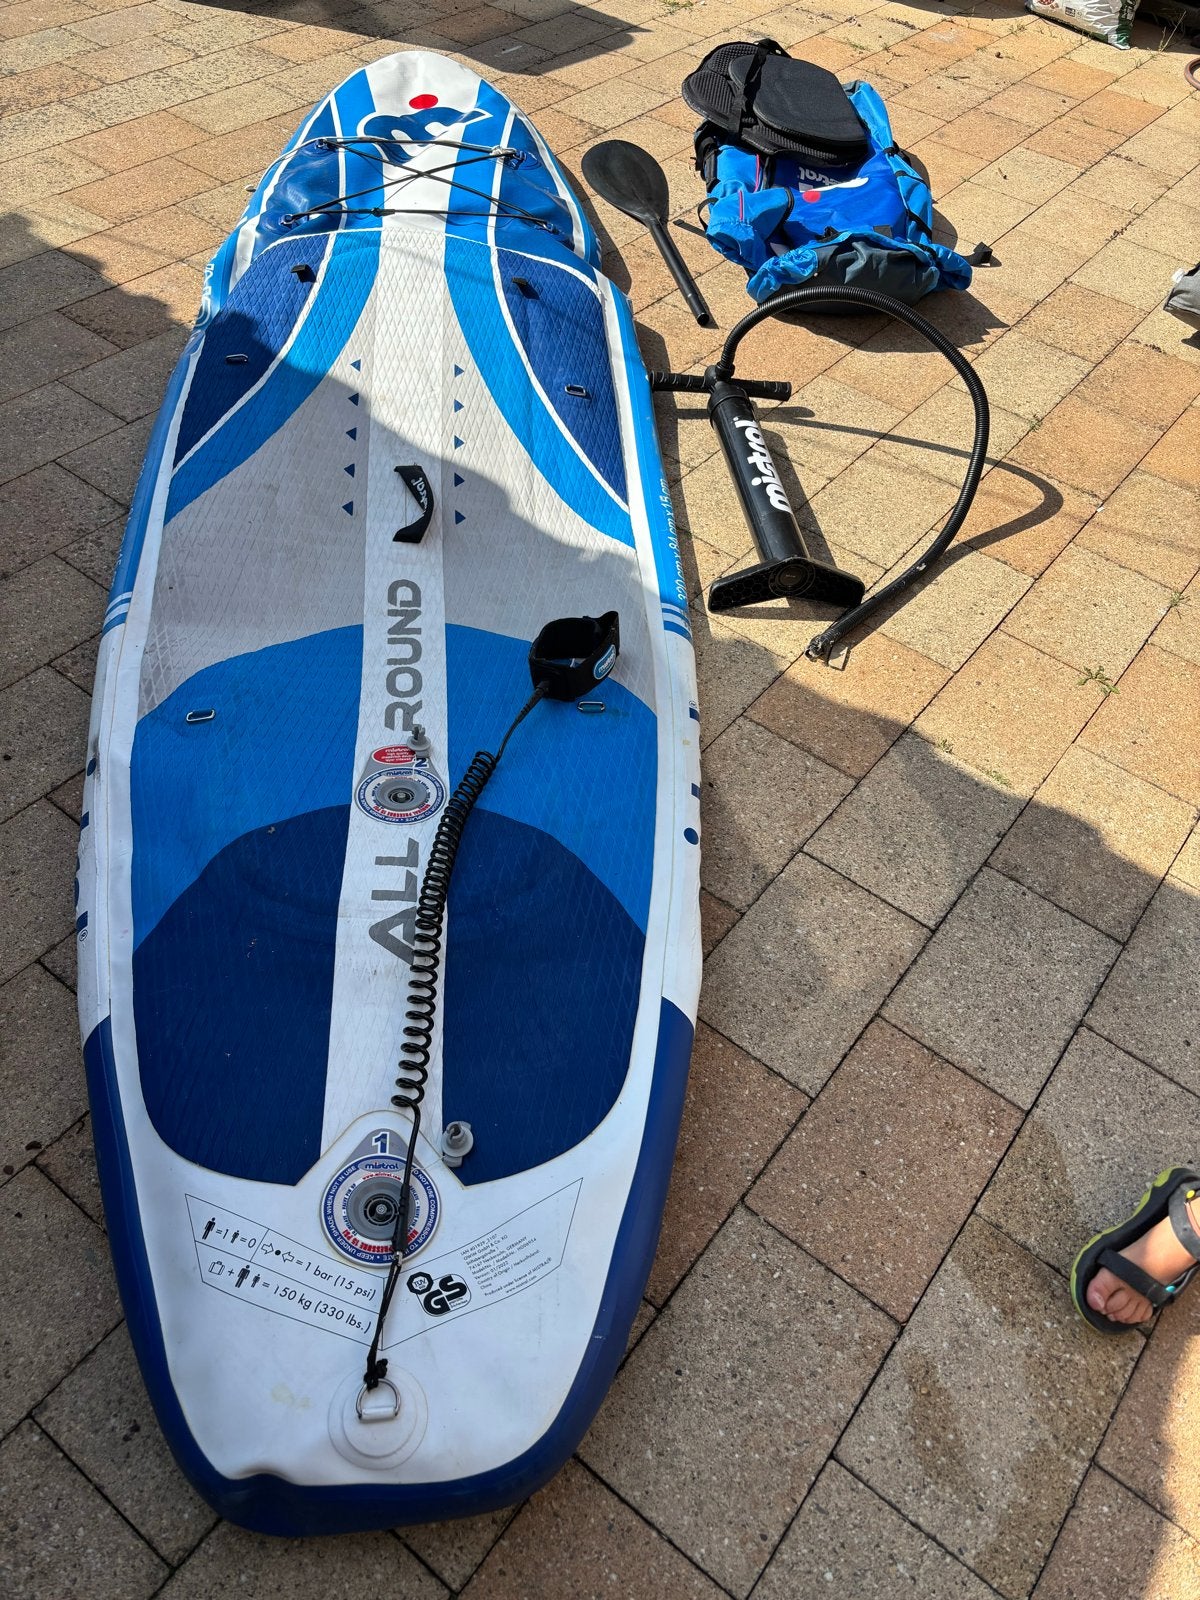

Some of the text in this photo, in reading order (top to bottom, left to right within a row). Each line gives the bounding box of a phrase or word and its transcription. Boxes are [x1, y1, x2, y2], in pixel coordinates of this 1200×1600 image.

[734, 417, 793, 515] mistral
[384, 579, 423, 732] ROUND
[368, 837, 420, 966] ALL
[372, 1131, 390, 1155] 1
[343, 1164, 357, 1176] USE
[364, 1162, 399, 1170] mistral
[329, 1180, 340, 1194] NOT
[337, 1174, 345, 1182] IN
[417, 1172, 429, 1186] NOT
[425, 1185, 434, 1198] USE
[326, 1194, 334, 1214] WHEN
[327, 1214, 340, 1237] SHADE
[416, 1198, 436, 1244] COMPRESSOR
[336, 1235, 356, 1254] UNDER
[408, 1241, 418, 1251] TO
[477, 1244, 490, 1253] GmbH
[506, 1236, 527, 1250] GERMANY
[355, 1250, 374, 1260] KEEP
[304, 1262, 312, 1272] 1
[313, 1265, 333, 1282] bar
[333, 1274, 354, 1290] (15
[353, 1286, 377, 1302] psi)
[423, 1275, 467, 1315] GS
[273, 1284, 297, 1301] 150
[298, 1293, 312, 1310] kg
[313, 1300, 345, 1321] (330
[345, 1313, 372, 1334] lbs.)
